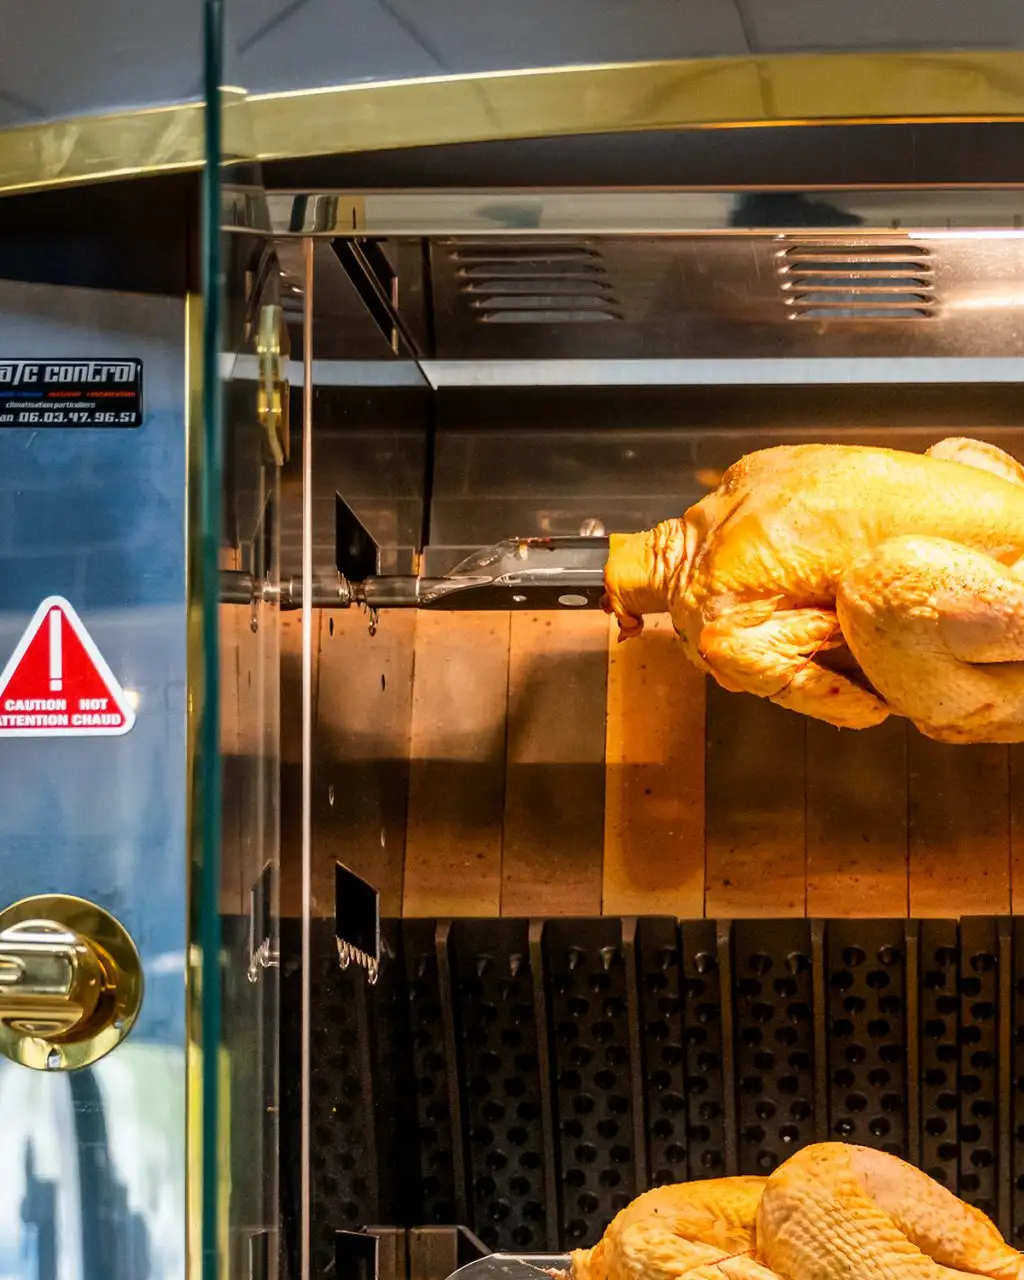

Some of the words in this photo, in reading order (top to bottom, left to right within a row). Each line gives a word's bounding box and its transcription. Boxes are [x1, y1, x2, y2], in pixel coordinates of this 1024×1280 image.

[44, 362, 136, 383] control
[5, 698, 67, 711] CAUTION
[79, 698, 109, 710] HOT
[72, 714, 121, 726] CHAUD
